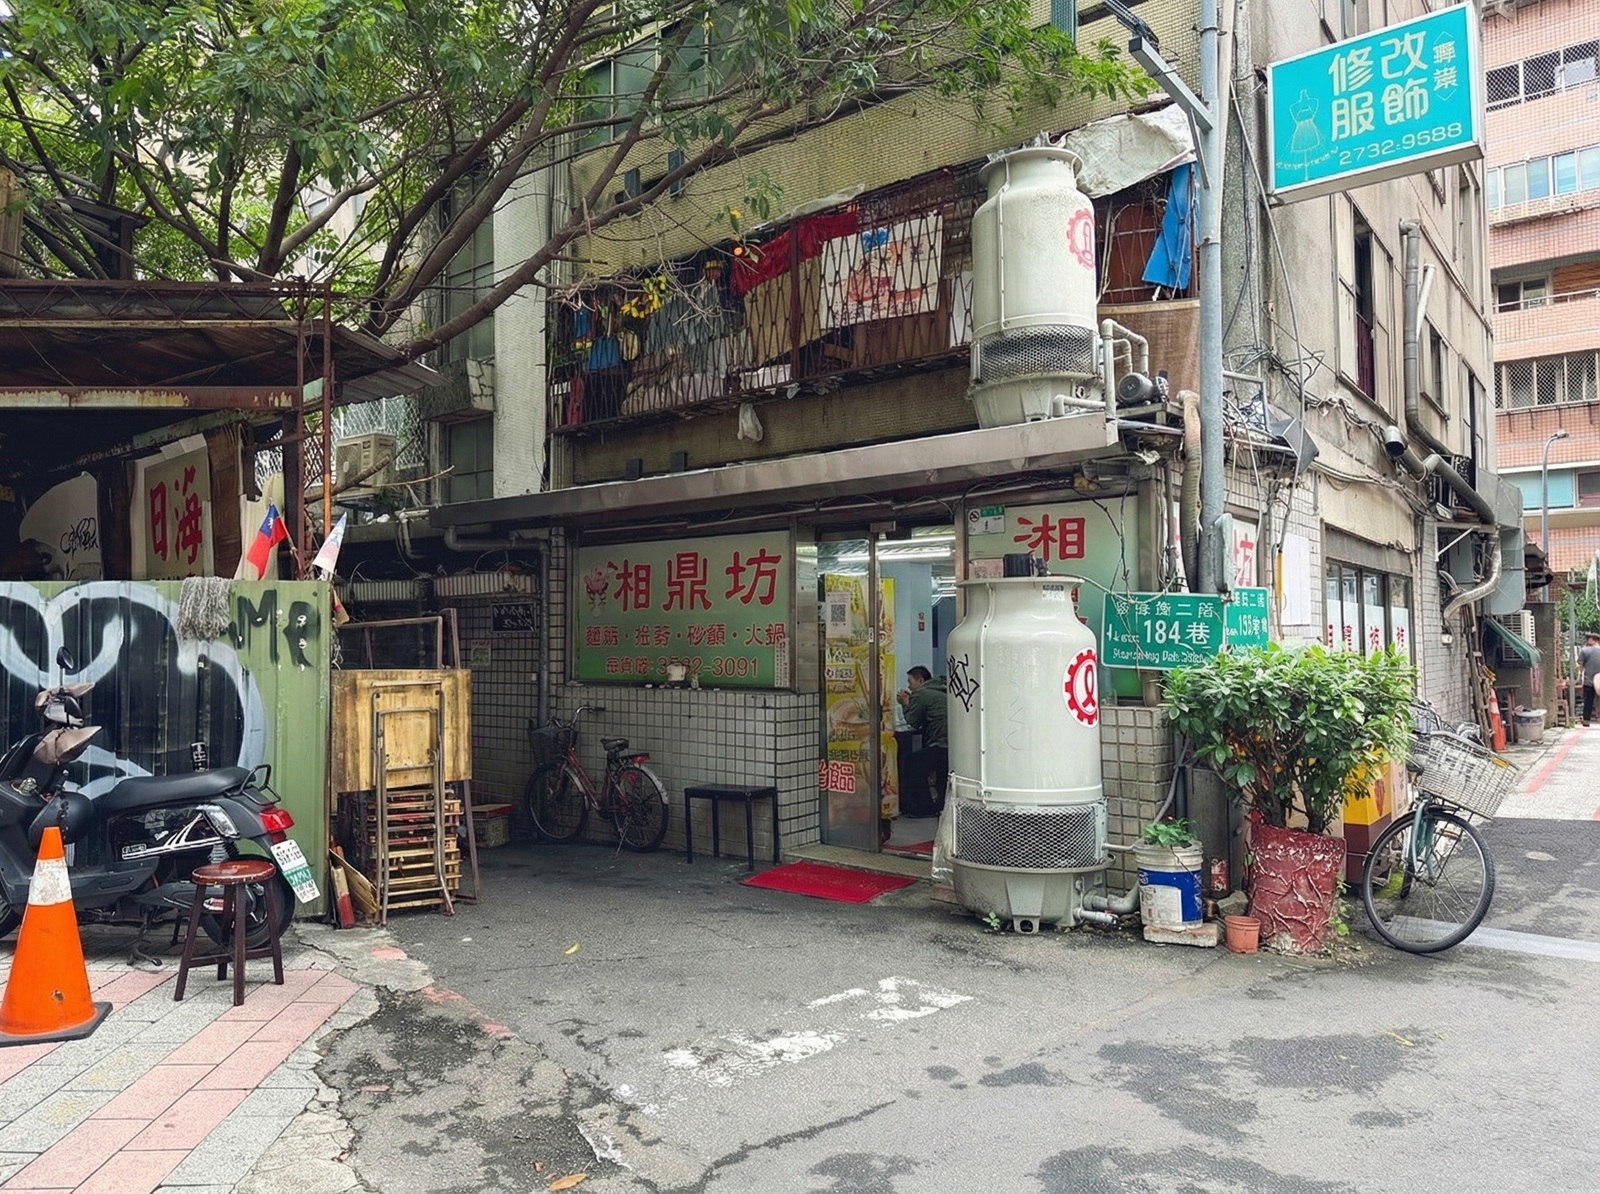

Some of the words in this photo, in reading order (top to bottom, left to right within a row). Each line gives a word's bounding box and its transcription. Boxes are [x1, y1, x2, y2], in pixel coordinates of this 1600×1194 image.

[1327, 30, 1429, 96] 修改
[1330, 77, 1430, 142] 服飾
[606, 547, 783, 613] 湘鼎坊
[1143, 619, 1212, 645] 184巷
